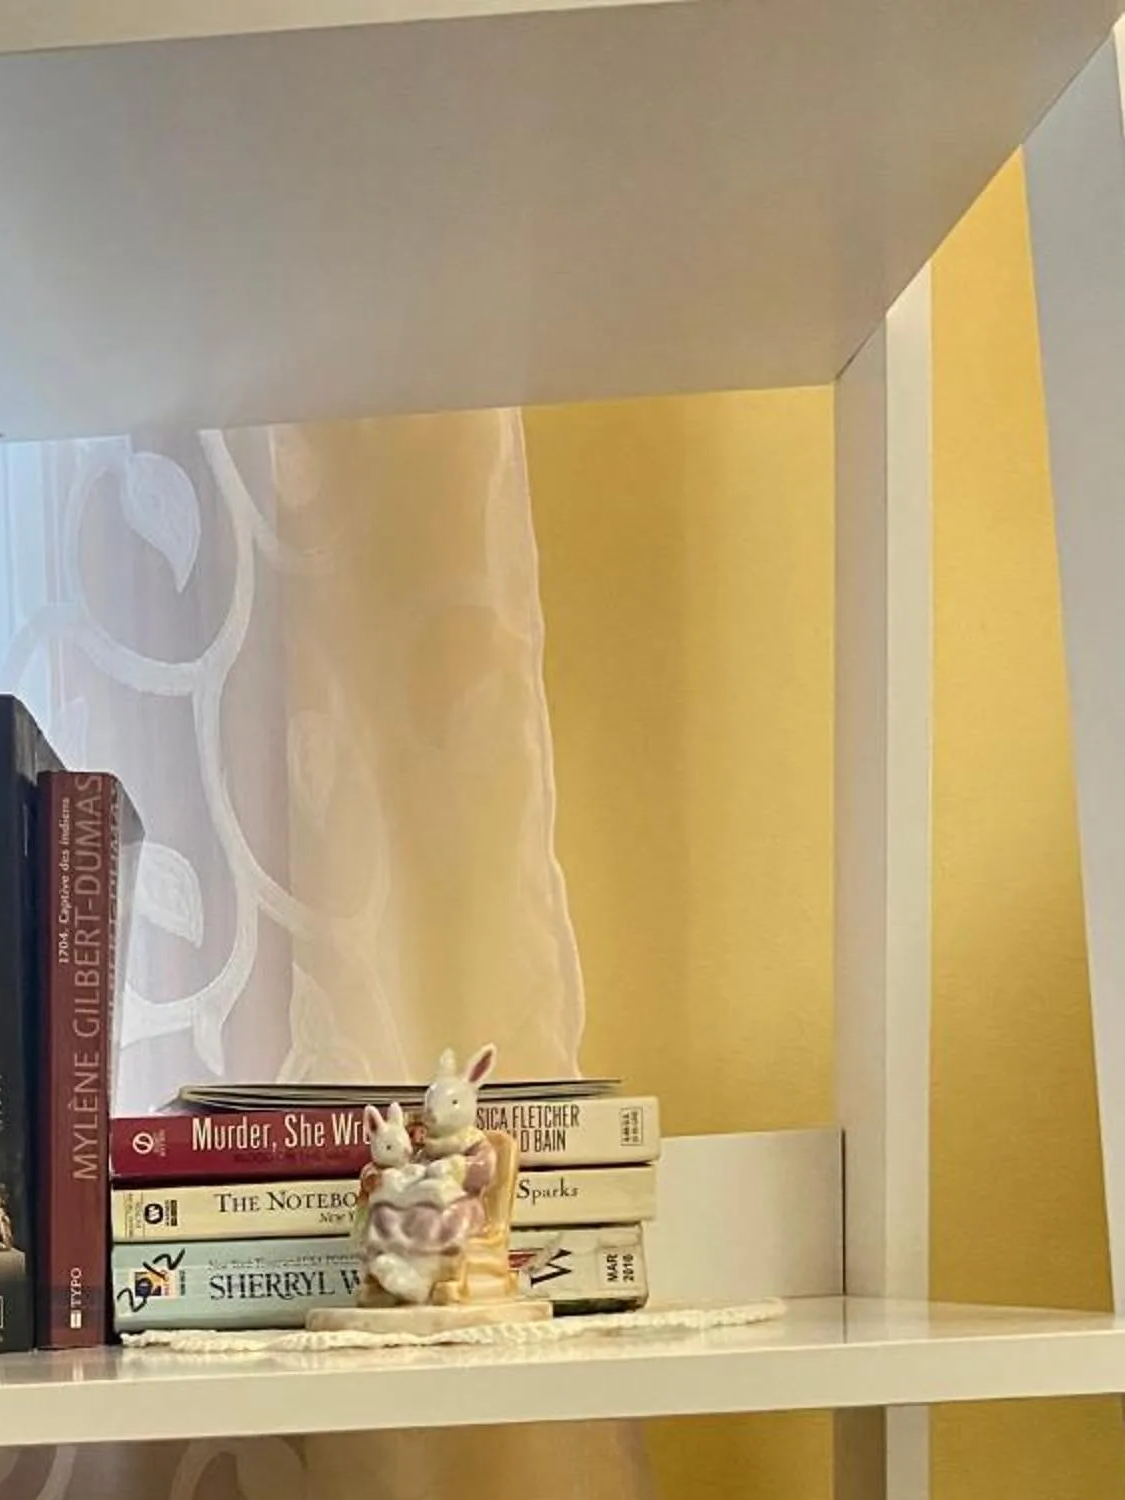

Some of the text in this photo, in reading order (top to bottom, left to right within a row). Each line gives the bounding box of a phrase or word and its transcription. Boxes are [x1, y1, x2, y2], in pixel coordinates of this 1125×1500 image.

[58, 848, 71, 872] des
[74, 774, 103, 1039] GILBERT-DUMAS
[283, 1113, 325, 1148] She
[331, 1111, 372, 1146] Wro
[476, 1103, 580, 1131] SICA FLETCHER
[534, 1128, 566, 1153] BAIN
[215, 1190, 357, 1214] THE NOTEBO
[516, 1177, 579, 1205] Sparks
[606, 1252, 619, 1283] MAR
[70, 1267, 82, 1307] TYPO
[208, 1270, 329, 1302] SHERRYL
